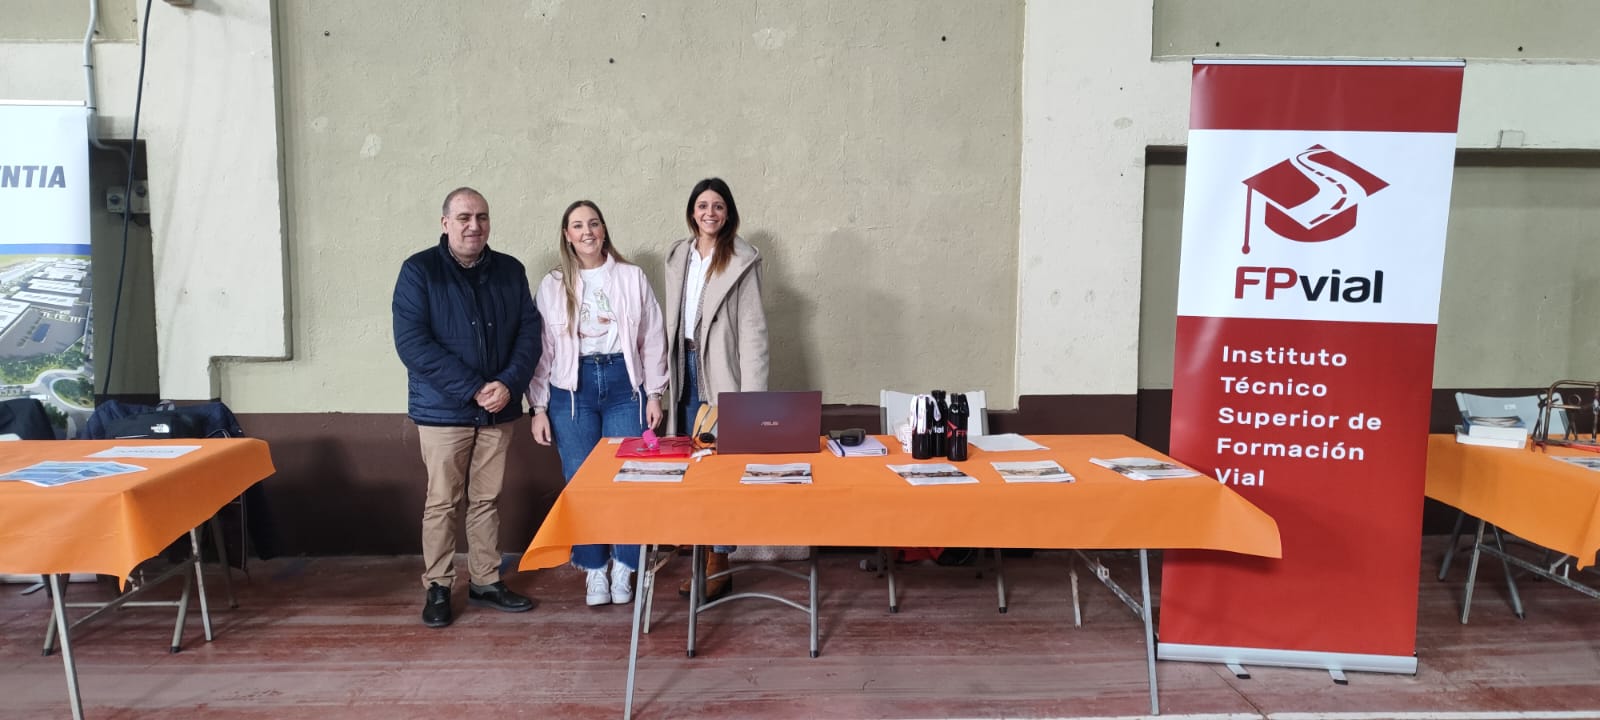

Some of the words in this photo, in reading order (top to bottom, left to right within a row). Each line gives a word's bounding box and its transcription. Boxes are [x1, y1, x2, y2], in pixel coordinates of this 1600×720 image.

[0, 165, 66, 188] NTIA
[1234, 266, 1384, 303] FPvial
[1222, 346, 1348, 367] Instituto
[1220, 376, 1327, 397] Técnico
[1218, 407, 1340, 429] Superior
[1348, 413, 1382, 430] de
[1216, 437, 1365, 461] Formación
[1214, 467, 1265, 487] Vial
